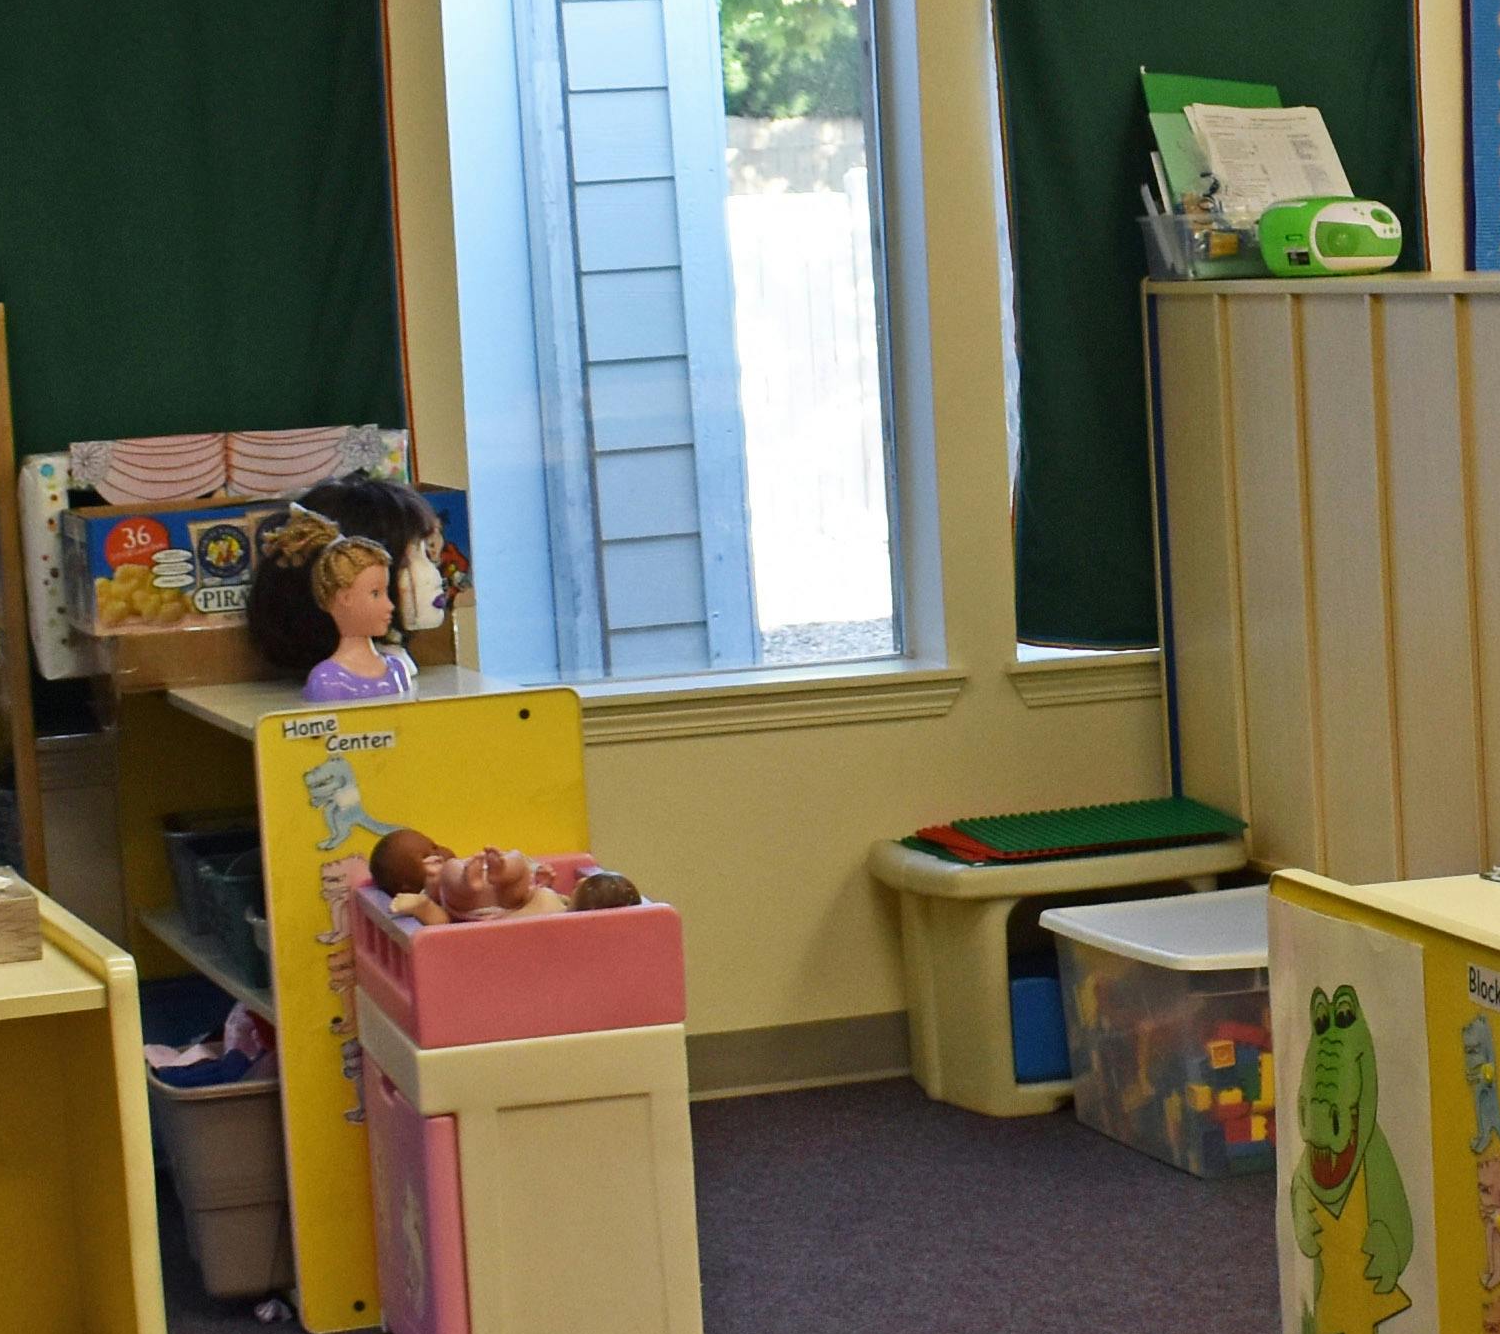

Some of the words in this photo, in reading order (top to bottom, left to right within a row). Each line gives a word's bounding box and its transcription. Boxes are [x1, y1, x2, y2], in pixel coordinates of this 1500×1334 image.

[121, 524, 152, 549] 36
[282, 718, 337, 739] Home
[325, 733, 392, 752] Center
